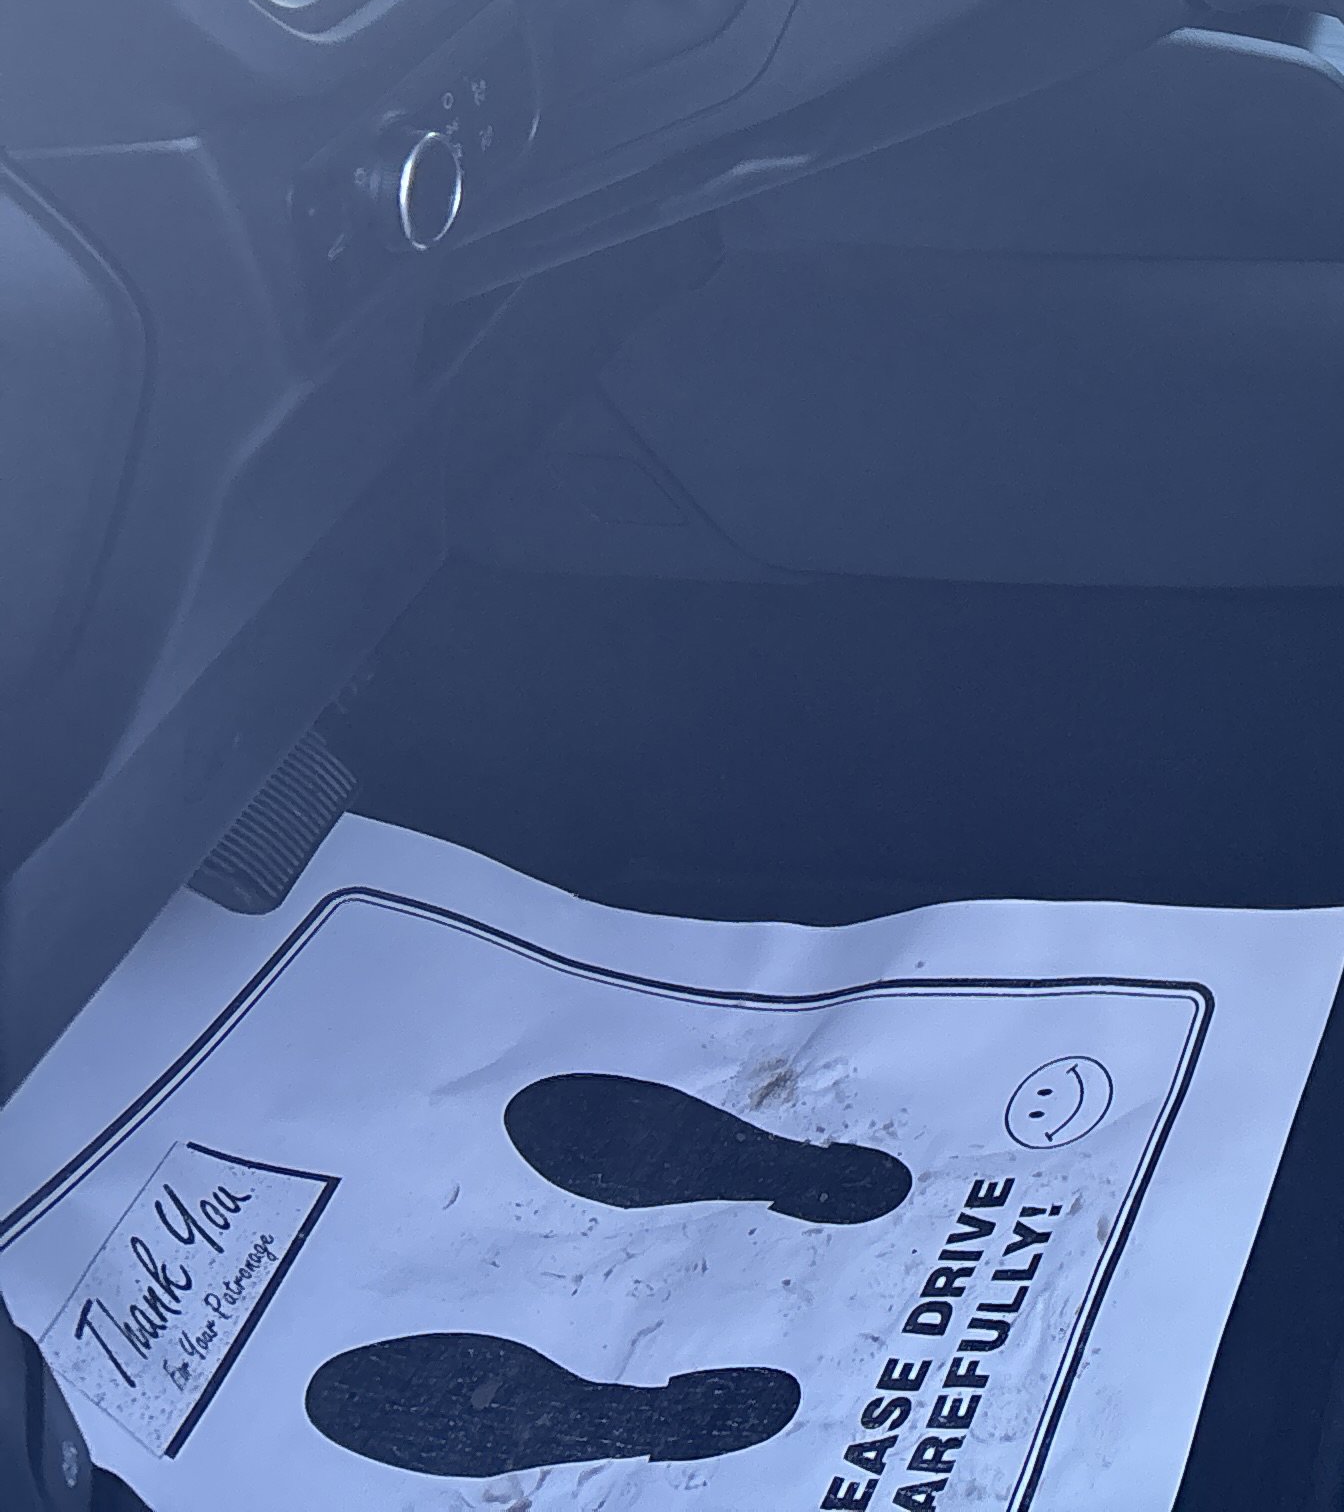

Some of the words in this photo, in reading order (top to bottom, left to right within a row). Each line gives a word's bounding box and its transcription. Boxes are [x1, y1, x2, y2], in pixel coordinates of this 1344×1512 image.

[75, 1236, 193, 1388] Thank
[154, 1183, 252, 1254] You
[203, 1233, 280, 1321] Patronage
[820, 1357, 933, 1512] EASE
[901, 1177, 1016, 1336] DRIVE
[892, 1204, 1063, 1512] AREFULLY!
